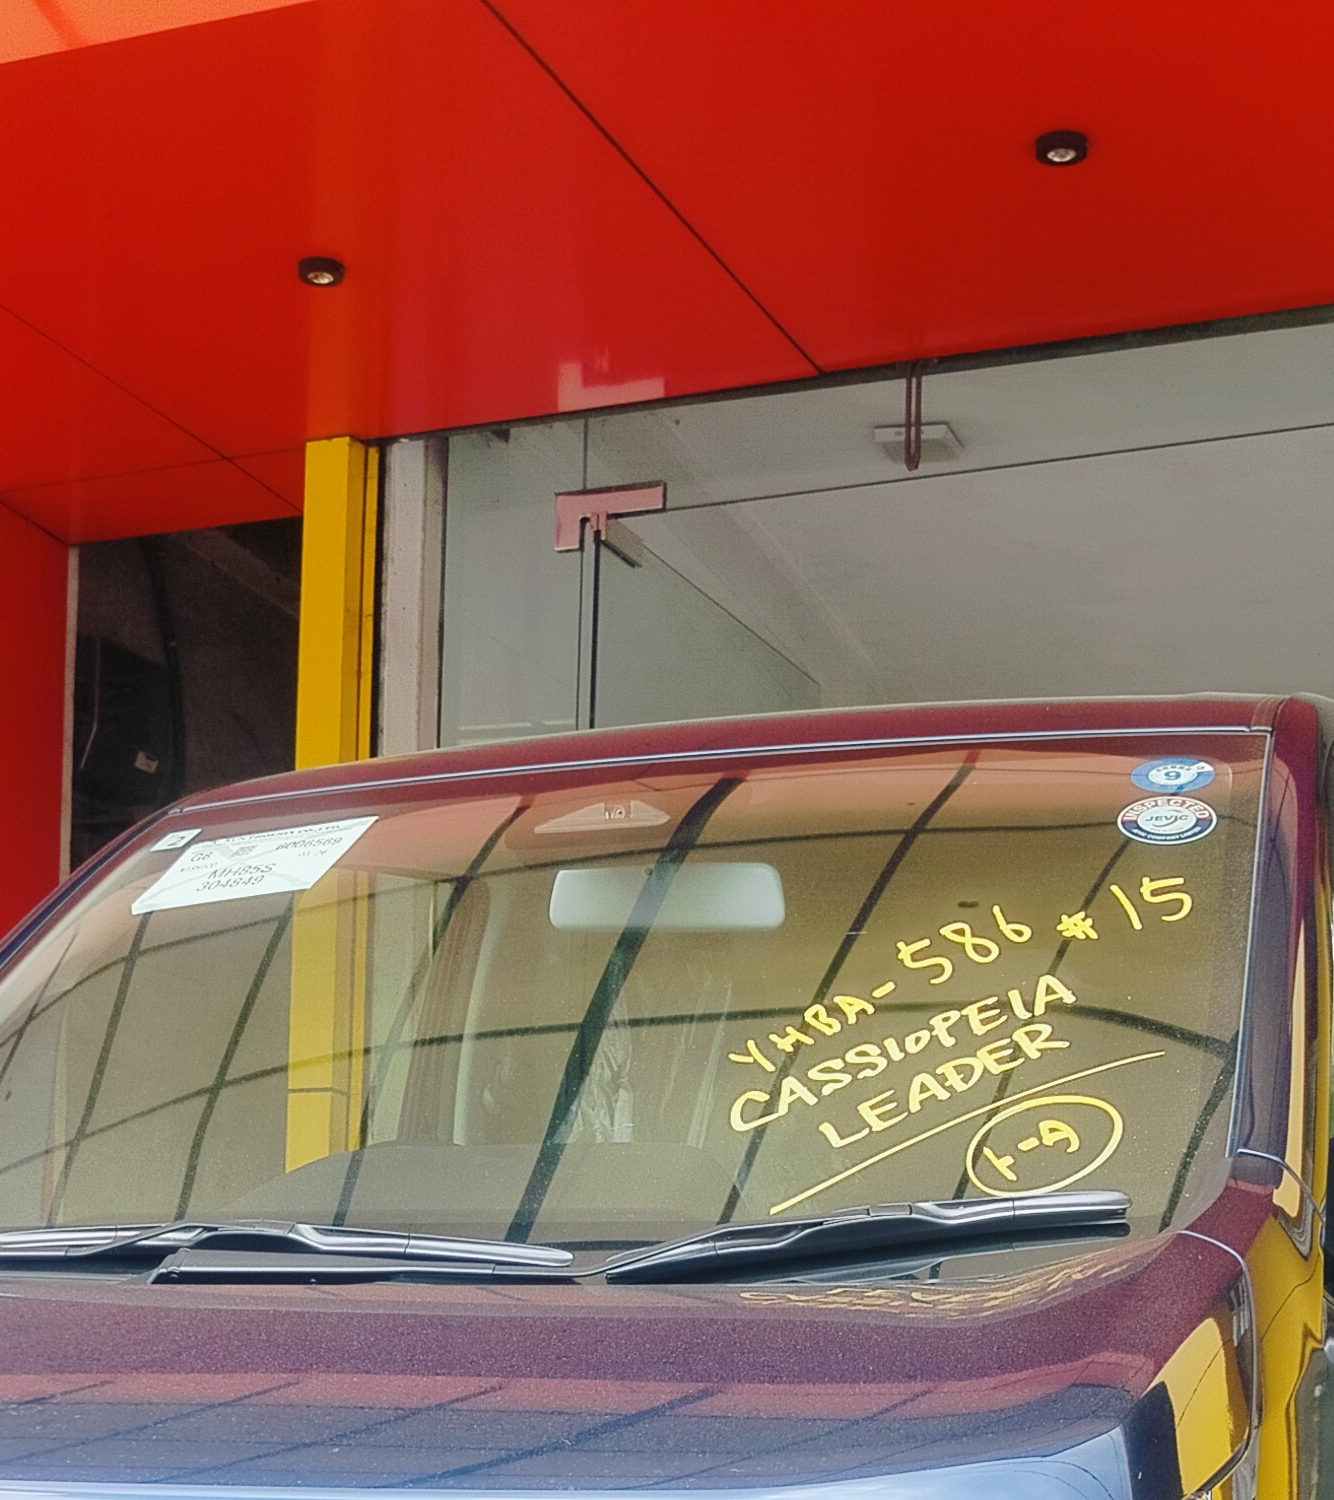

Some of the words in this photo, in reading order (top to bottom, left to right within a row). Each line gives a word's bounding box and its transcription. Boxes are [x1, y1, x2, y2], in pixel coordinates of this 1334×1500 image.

[1122, 799, 1211, 821] INSPECTED
[1145, 814, 1189, 822] JEVIC
[819, 1022, 1071, 1149] LEADER
